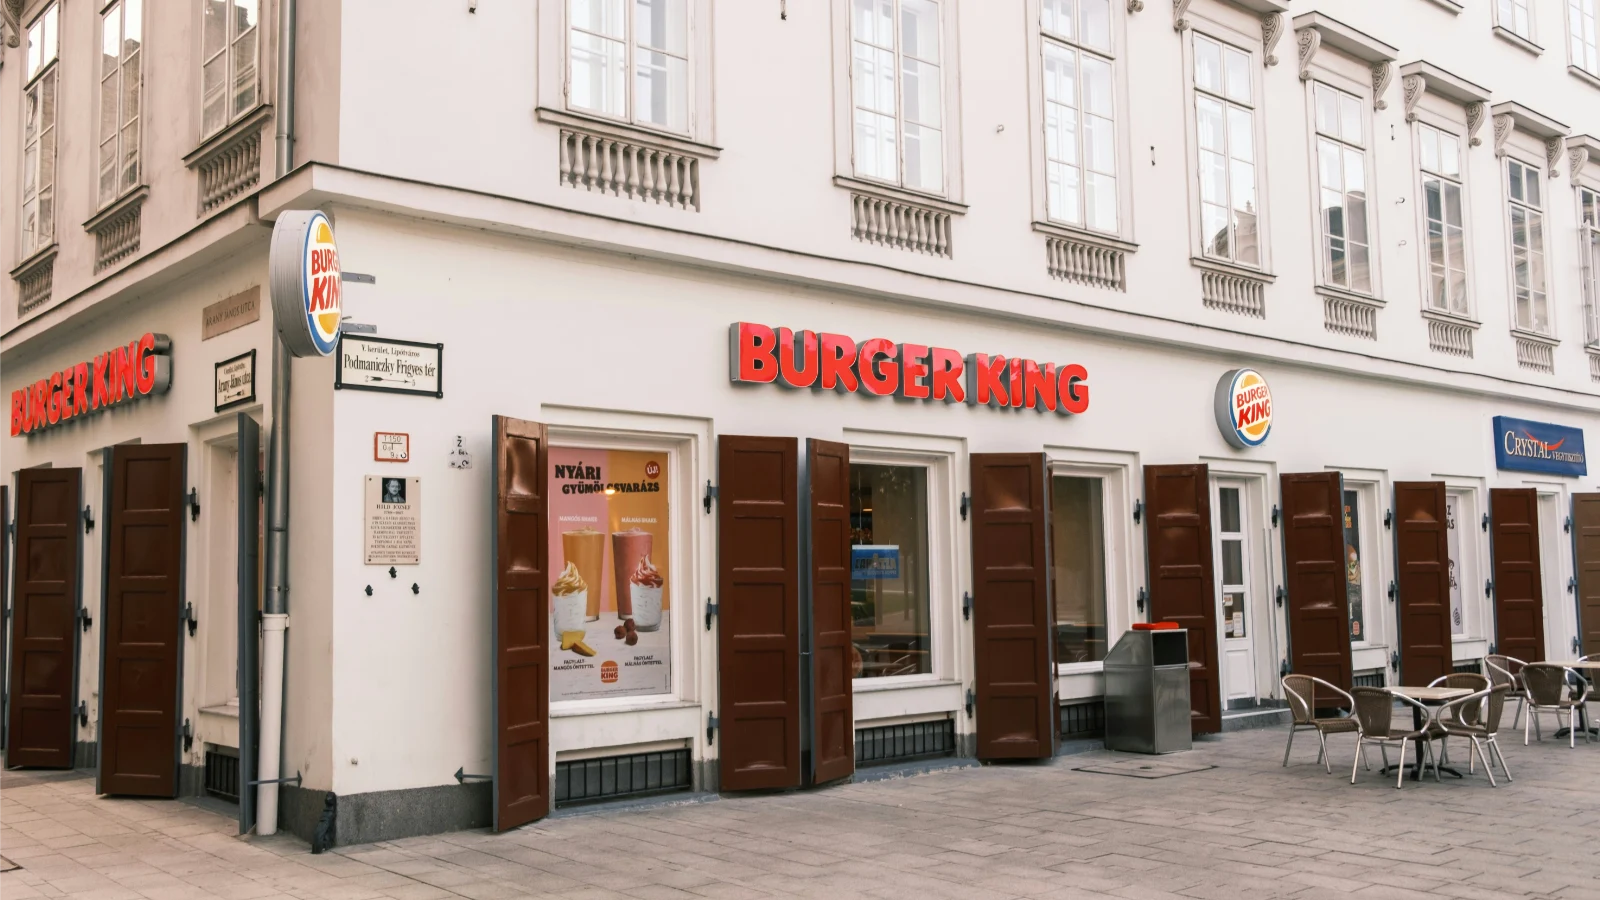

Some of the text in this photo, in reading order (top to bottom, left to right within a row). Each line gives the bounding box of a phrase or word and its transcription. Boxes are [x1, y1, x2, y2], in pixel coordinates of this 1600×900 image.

[240, 300, 255, 314] UTCA
[361, 344, 420, 357] V. kerület, Lipótváros
[344, 353, 436, 378] Podmaniczky Frigyes tér
[738, 321, 1090, 415] BURGER KING
[11, 332, 155, 437] BURGER KING
[1236, 386, 1268, 409] BURGER
[1238, 398, 1271, 429] KING
[1504, 430, 1551, 459] CRYSTAL
[555, 461, 601, 480] NYÁRI
[647, 464, 659, 475] ÚJ!
[559, 514, 580, 522] MANGÓS
